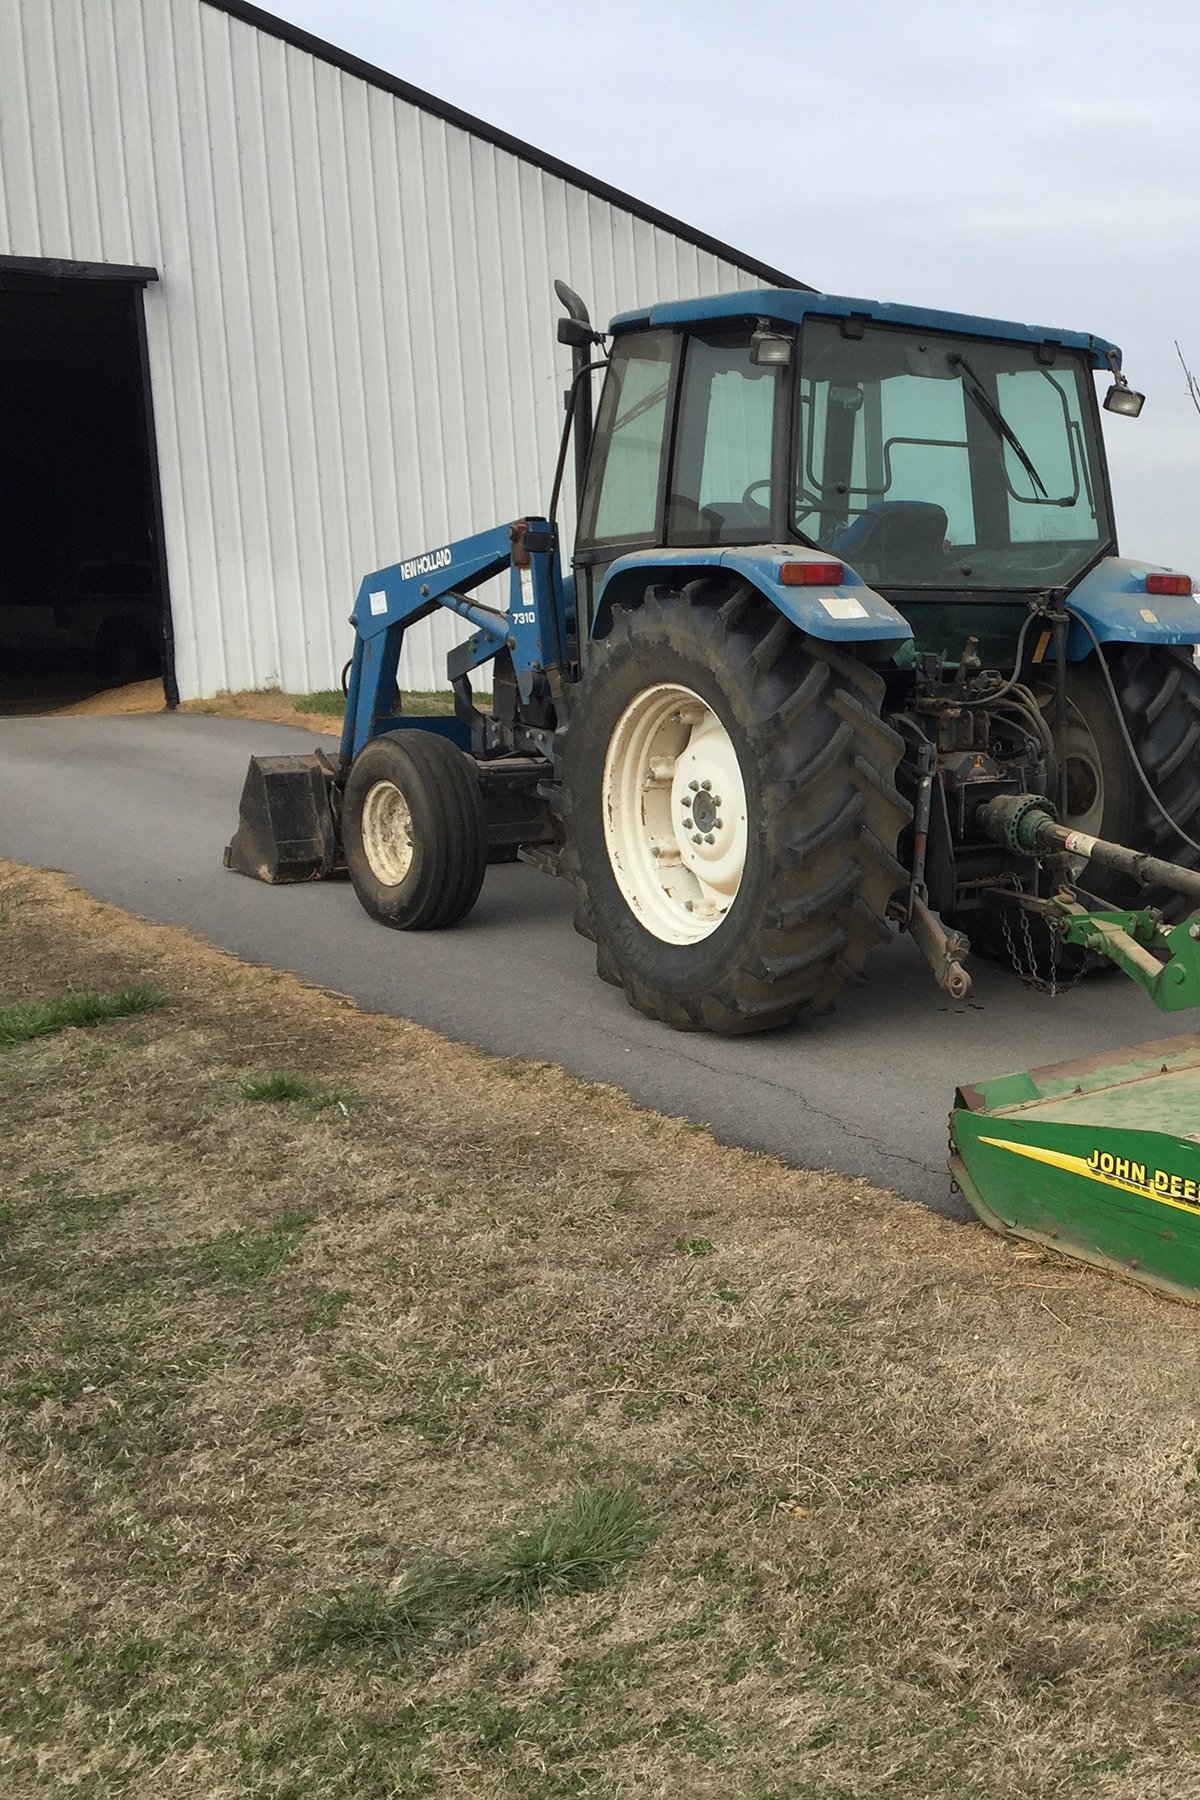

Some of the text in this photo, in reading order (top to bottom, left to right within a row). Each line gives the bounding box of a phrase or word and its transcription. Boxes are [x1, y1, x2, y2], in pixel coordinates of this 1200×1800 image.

[401, 548, 452, 581] NEW HOLLAND
[512, 611, 536, 625] 7310
[1087, 1149, 1147, 1186] JOHN
